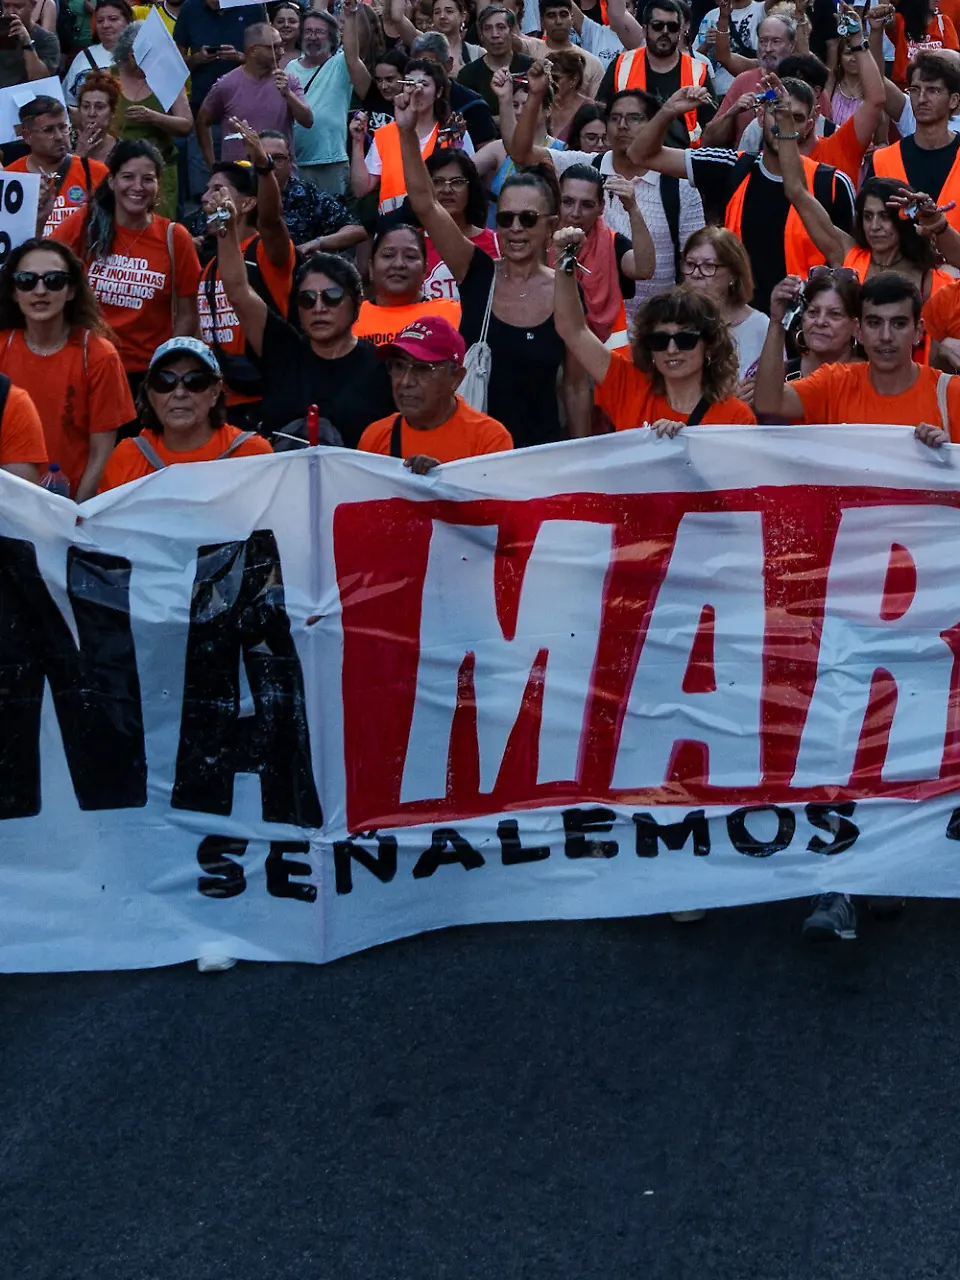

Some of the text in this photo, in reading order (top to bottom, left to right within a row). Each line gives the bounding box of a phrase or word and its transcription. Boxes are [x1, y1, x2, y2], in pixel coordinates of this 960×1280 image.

[92, 263, 164, 287] DE INQUILINAS
[97, 280, 155, 300] INQUILINOS
[101, 294, 143, 310] MADRID
[195, 801, 859, 904] SEÑALEMOS
